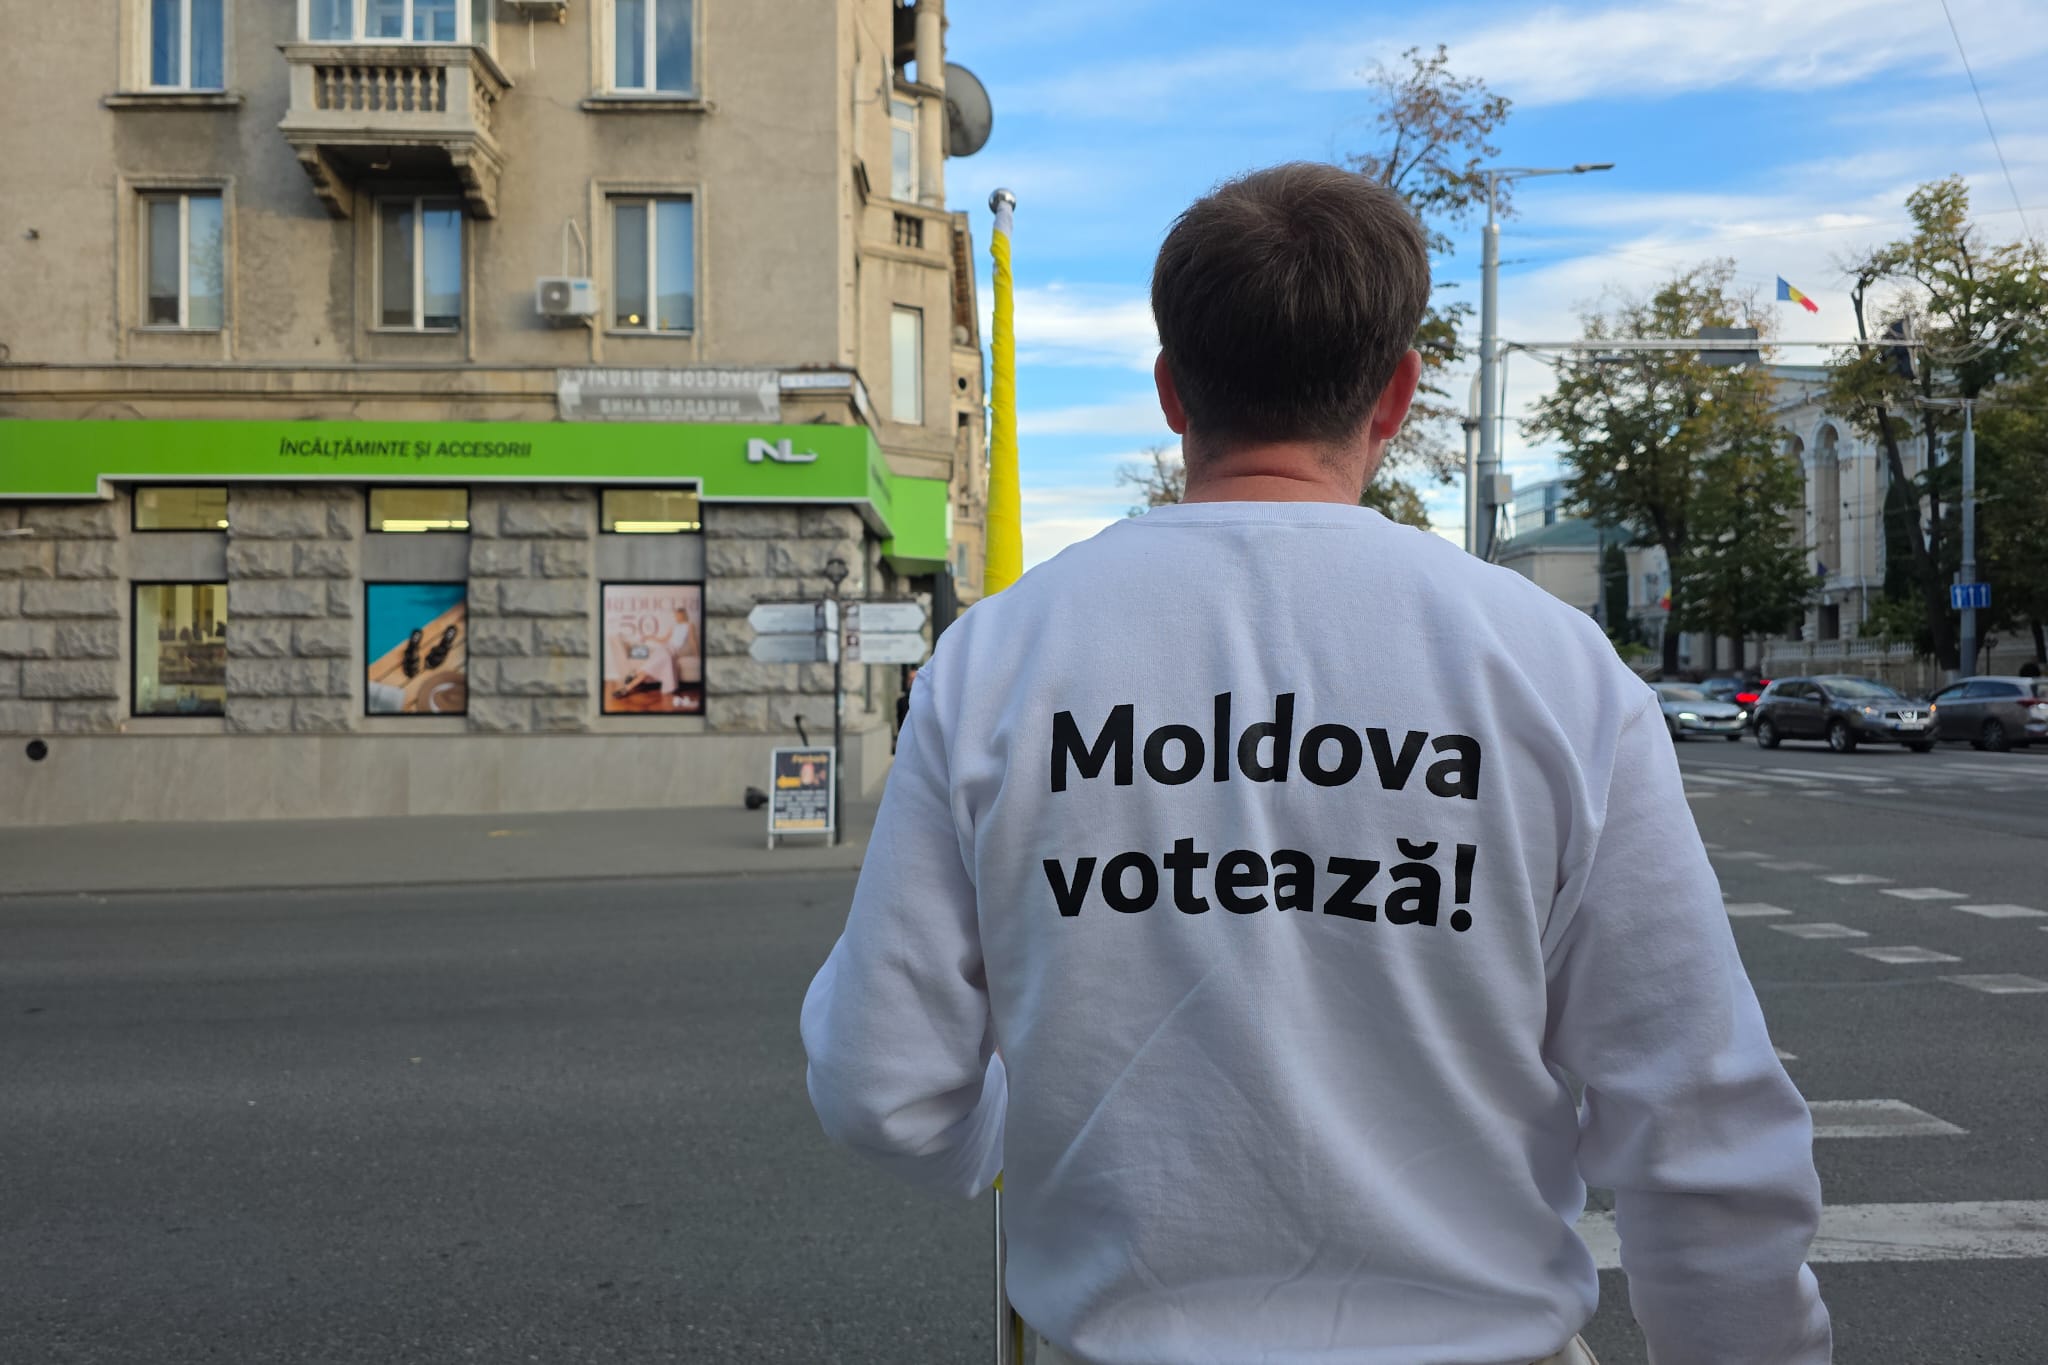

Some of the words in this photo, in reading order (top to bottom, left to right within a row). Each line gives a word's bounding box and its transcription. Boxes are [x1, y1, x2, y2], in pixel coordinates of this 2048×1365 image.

[435, 440, 532, 459] ACCESORII
[1050, 692, 1481, 800] Moldova
[1043, 837, 1477, 933] votează!
